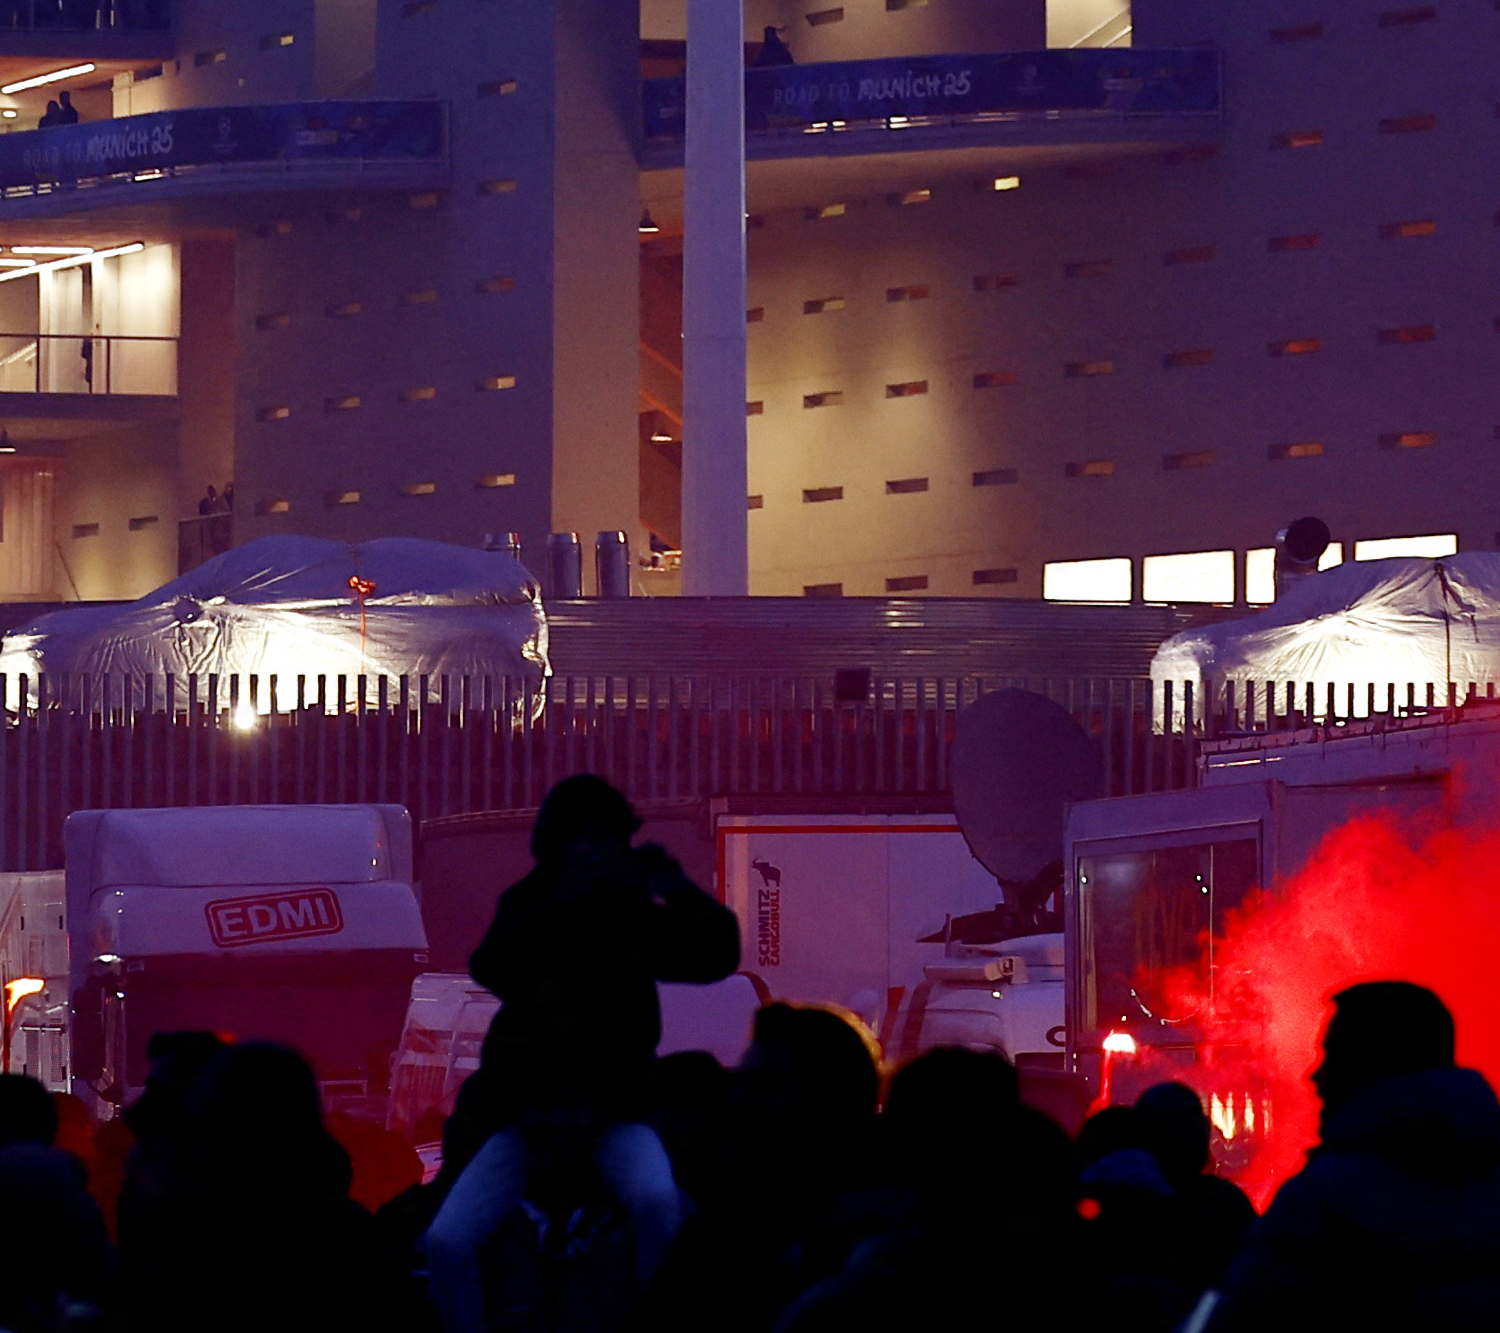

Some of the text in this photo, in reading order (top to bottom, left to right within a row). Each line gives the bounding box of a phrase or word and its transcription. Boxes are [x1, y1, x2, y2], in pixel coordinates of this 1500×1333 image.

[773, 86, 819, 105] ROAD
[826, 83, 850, 101] TO
[216, 894, 332, 939] EDMI
[759, 889, 770, 967] SCHMITZ
[771, 889, 780, 967] CARGOBULL
